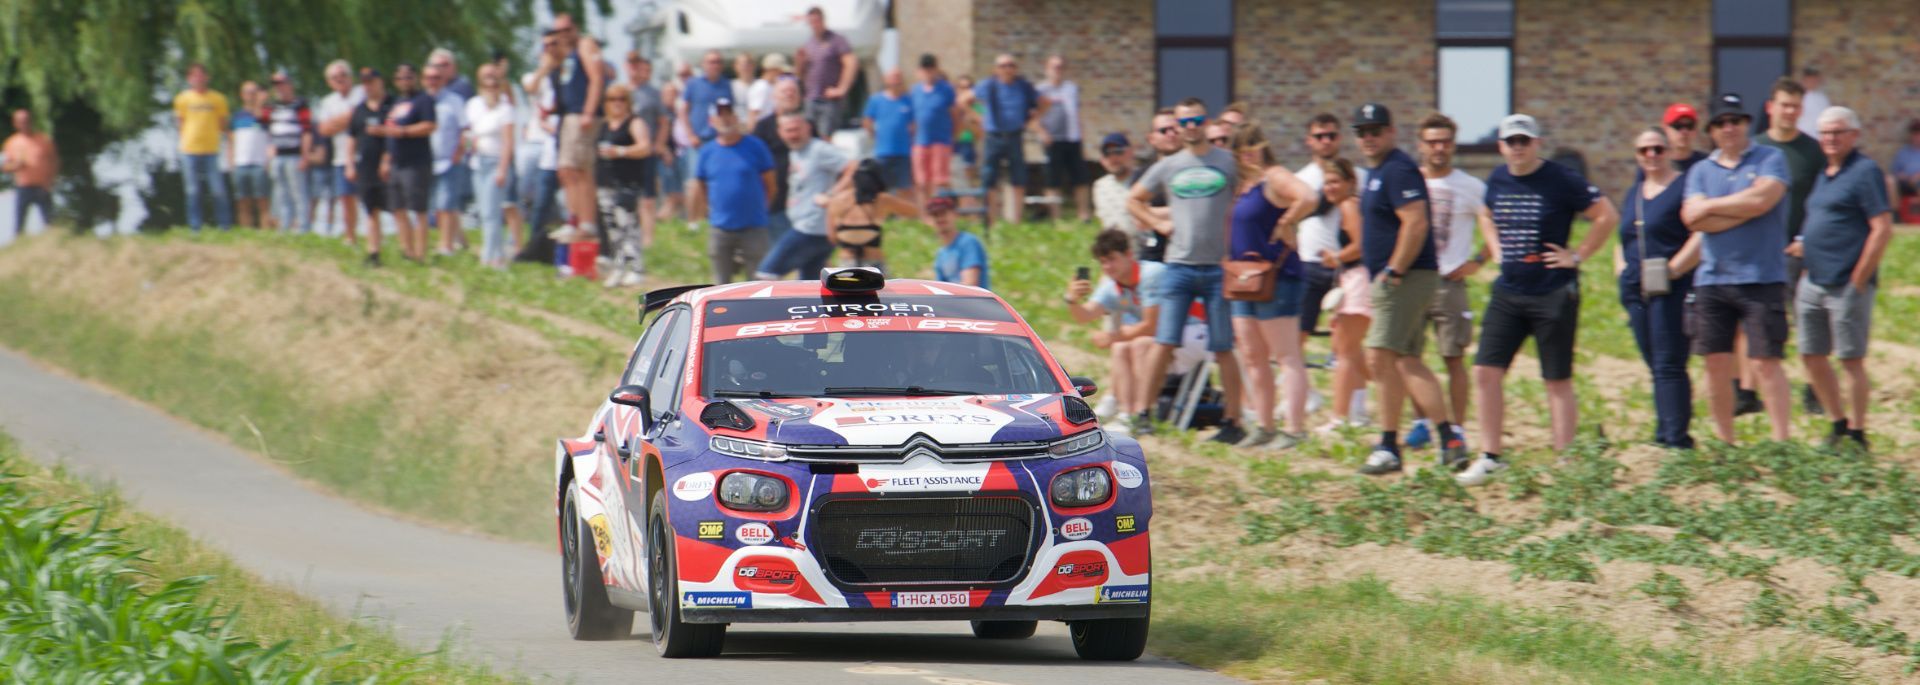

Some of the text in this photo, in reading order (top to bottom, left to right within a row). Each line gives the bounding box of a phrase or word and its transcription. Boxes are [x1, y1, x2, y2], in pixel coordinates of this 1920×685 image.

[736, 321, 818, 337] BRC
[917, 319, 999, 331] BRC
[892, 476, 982, 486] FLEET ASSISTANCE
[699, 524, 723, 536] OMP
[1065, 521, 1090, 534] BELL
[1117, 519, 1135, 530] OMP
[741, 527, 771, 538] BELL
[900, 593, 967, 605] 1-HCA-050
[1111, 589, 1149, 598] MICHELIN
[697, 596, 746, 605] MICHELIN
